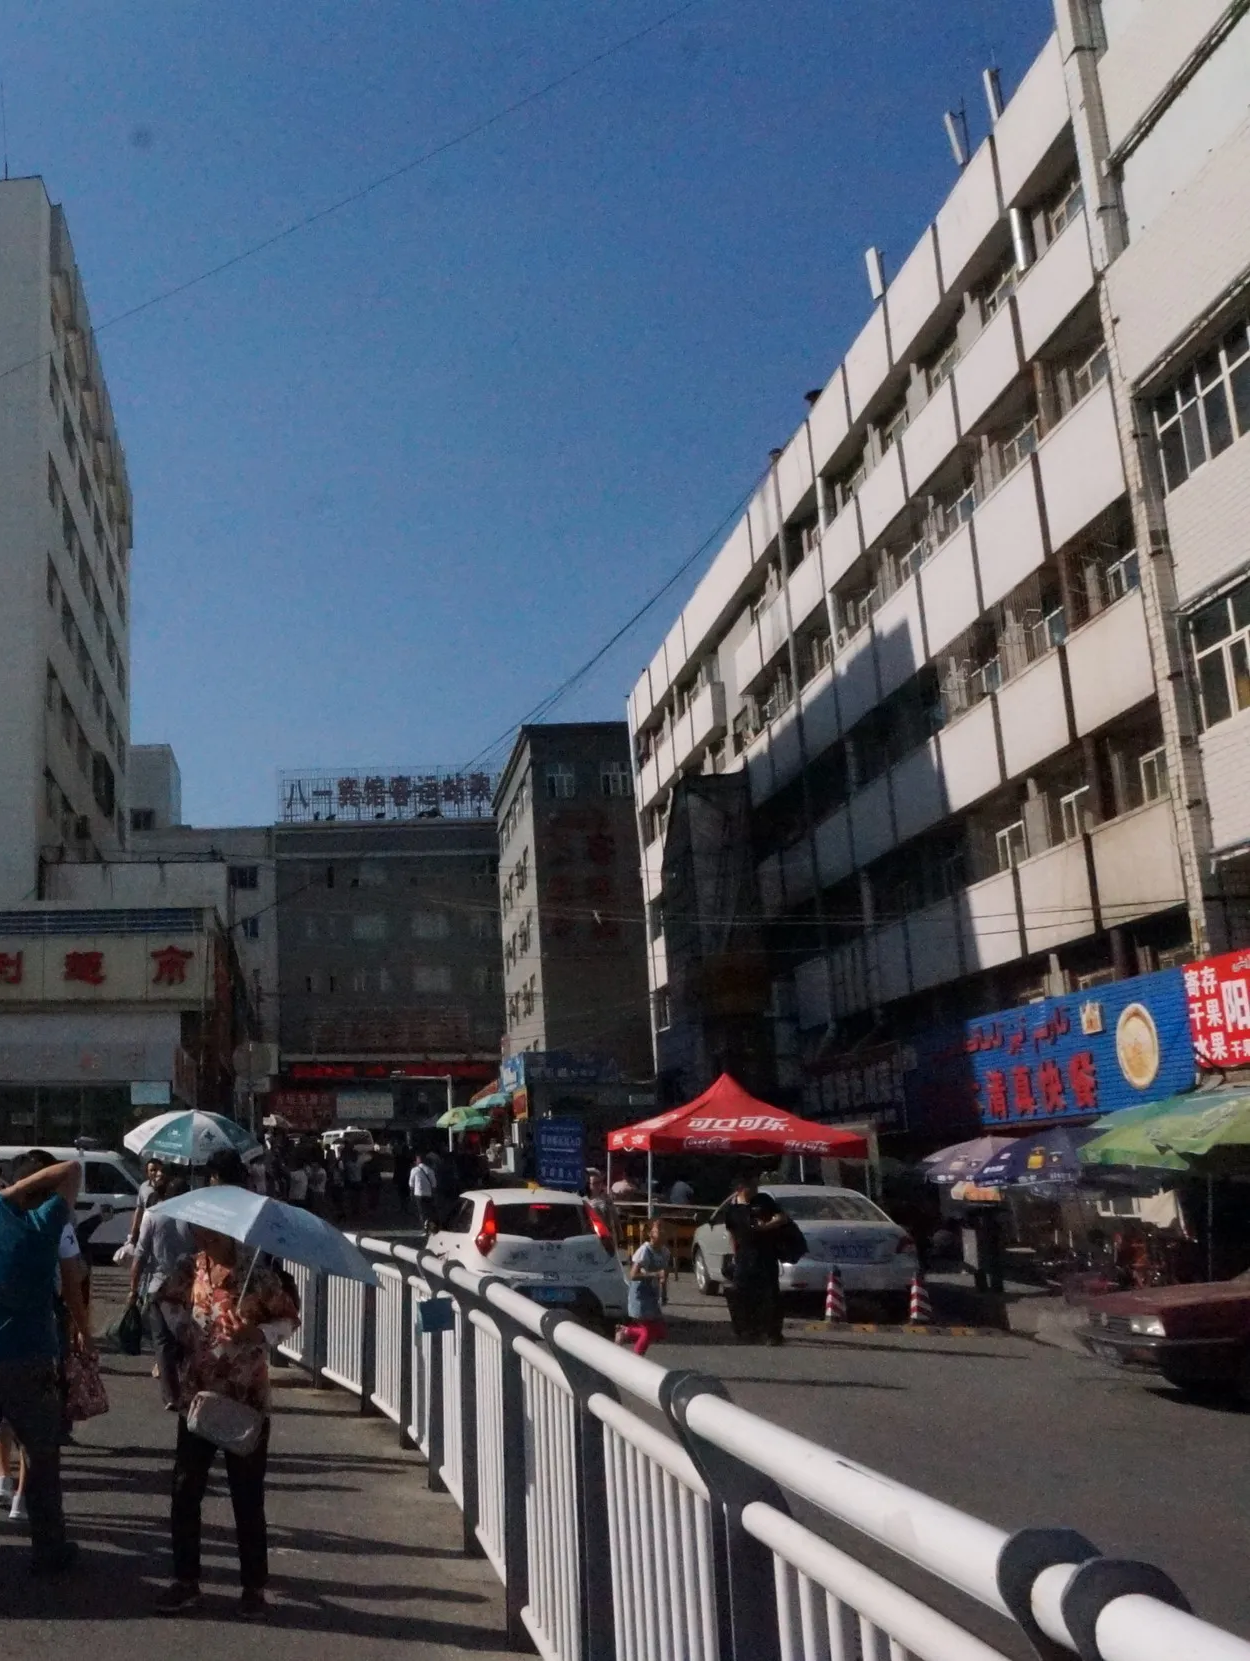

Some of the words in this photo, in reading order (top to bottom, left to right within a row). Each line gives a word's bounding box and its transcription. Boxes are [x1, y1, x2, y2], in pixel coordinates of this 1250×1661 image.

[1184, 965, 1218, 998] 寄存
[1189, 998, 1224, 1030] 干果
[1194, 1031, 1229, 1063] 水果
[985, 1051, 1099, 1119] 清真快餐
[687, 1115, 790, 1133] 可口可乐
